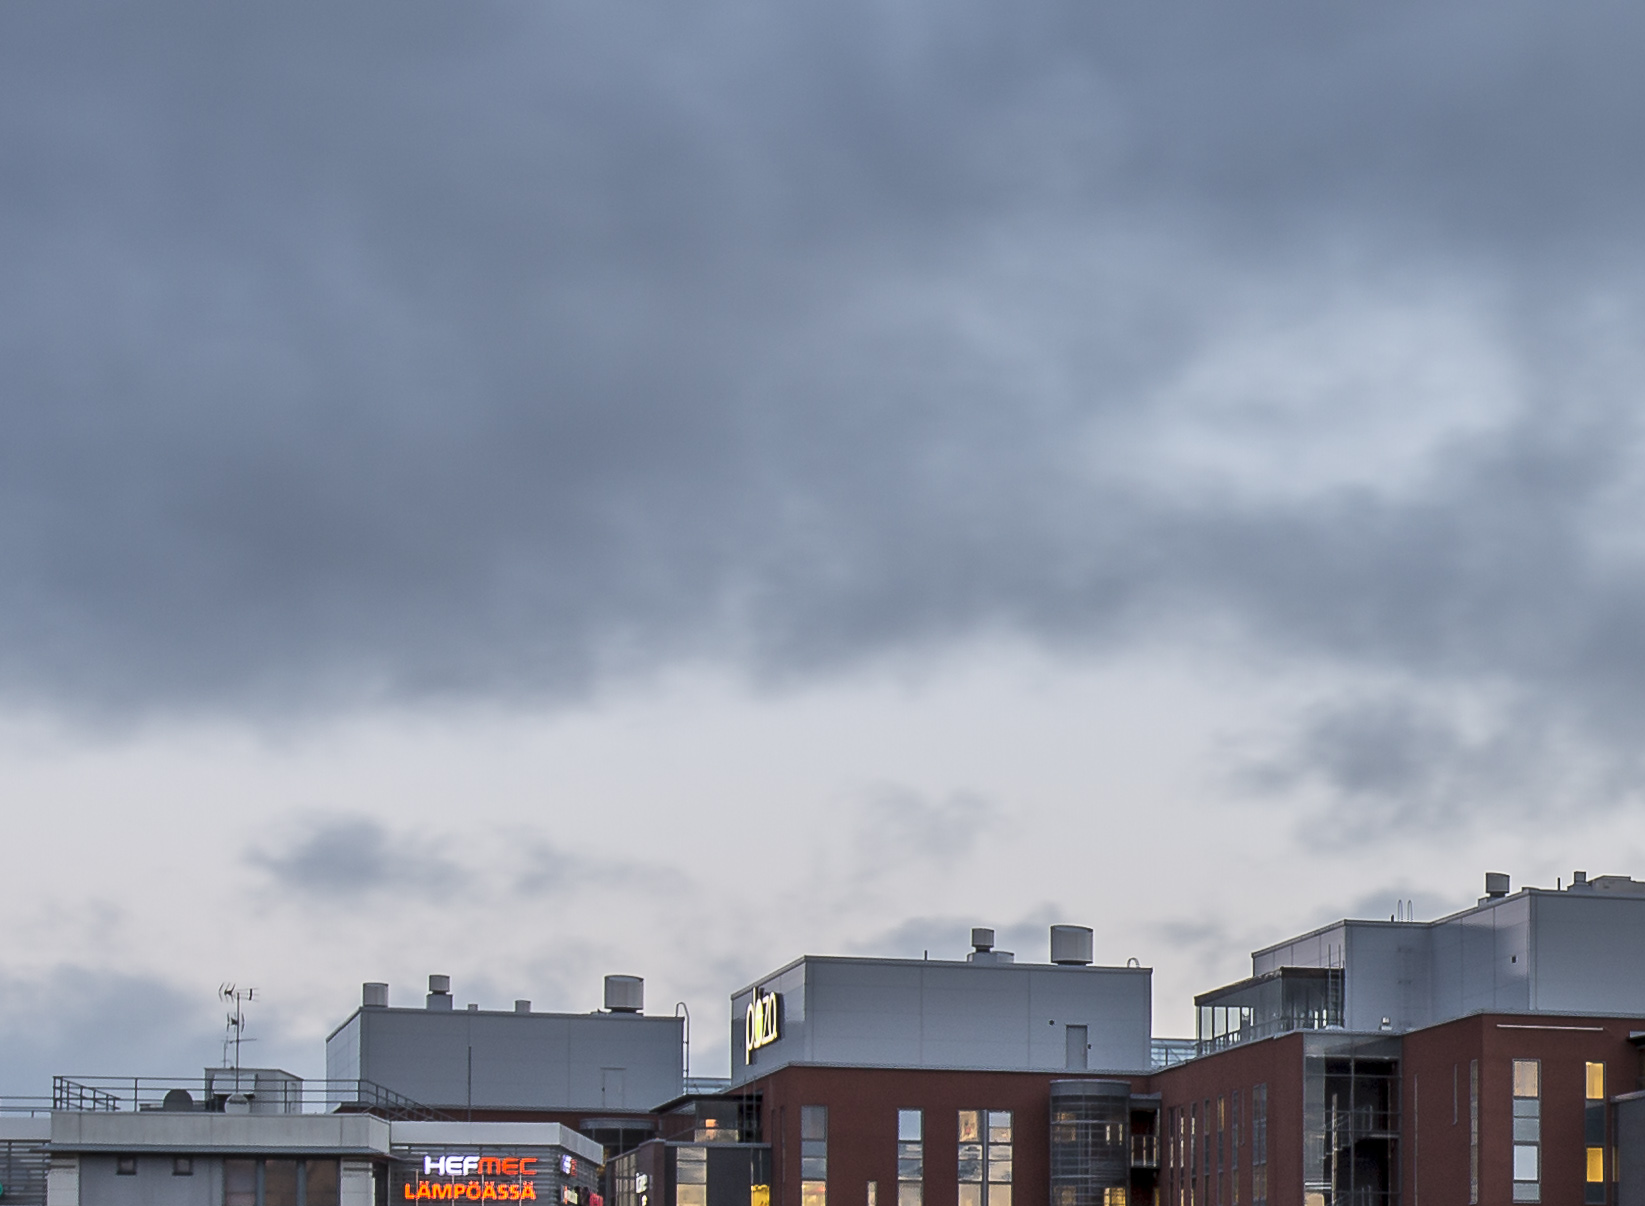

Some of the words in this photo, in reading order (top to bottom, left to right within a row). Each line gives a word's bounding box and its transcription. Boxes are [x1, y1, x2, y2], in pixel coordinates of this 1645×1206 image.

[745, 987, 778, 1065] plaza
[424, 1155, 538, 1176] HEFMEC
[404, 1180, 537, 1201] LÄMPÖÄSSÄ
